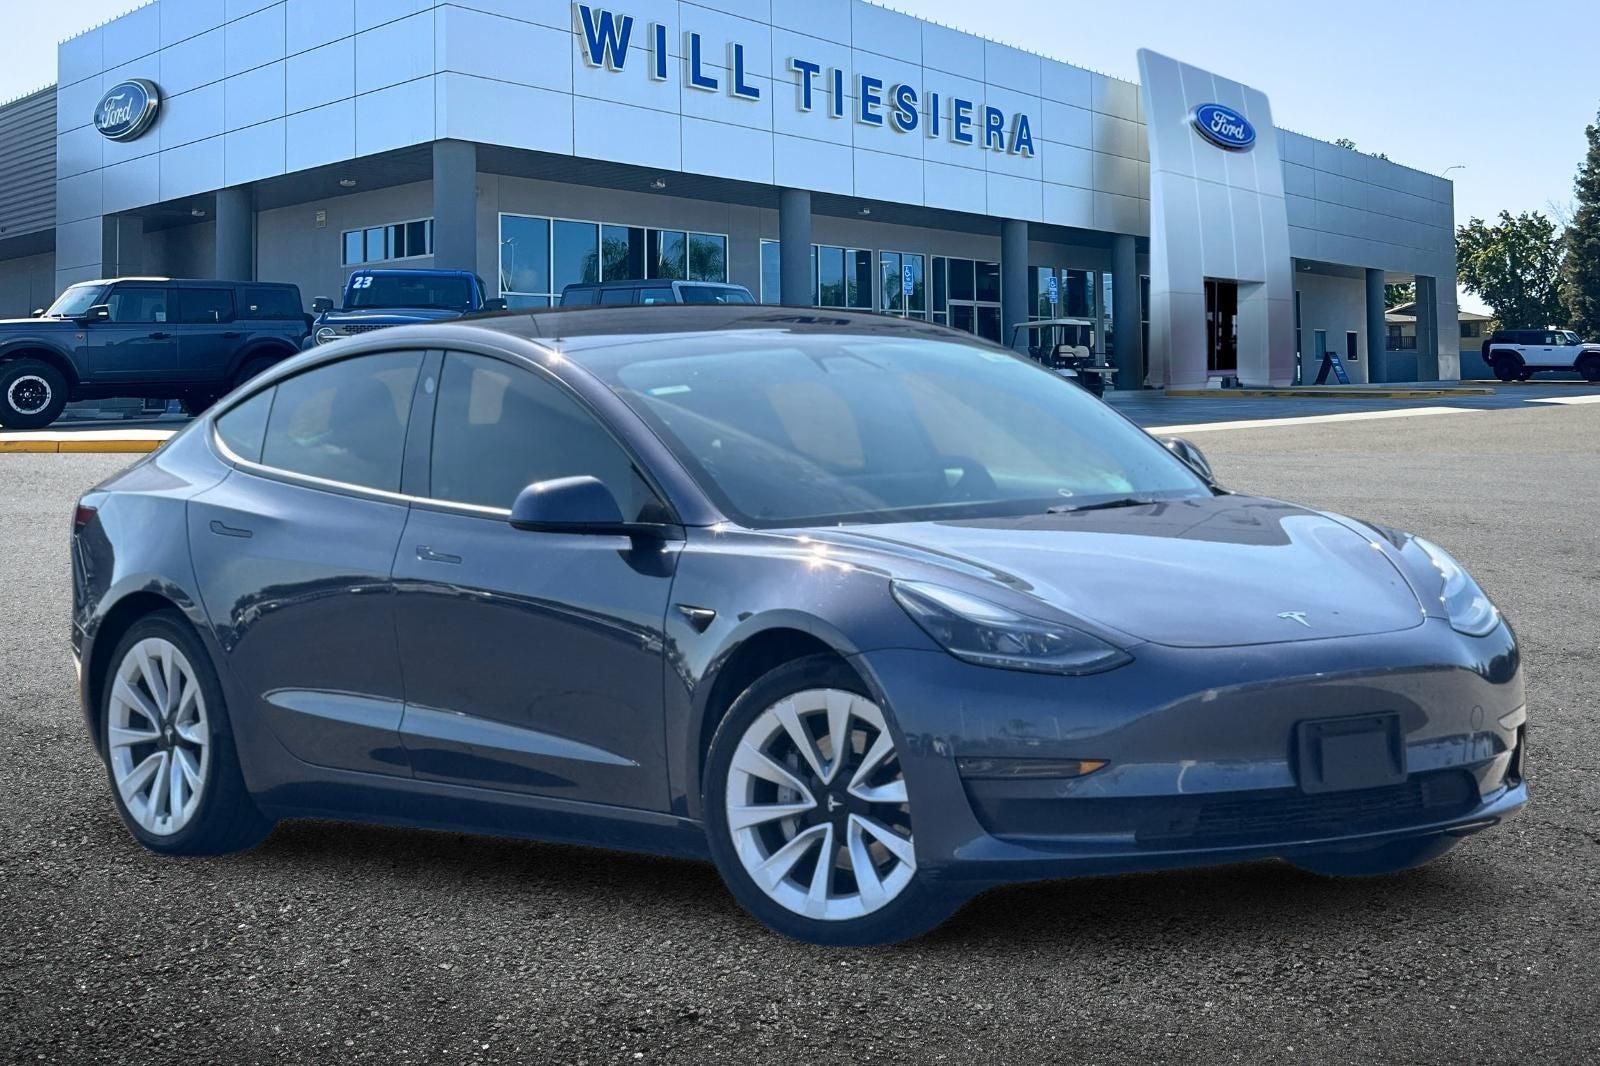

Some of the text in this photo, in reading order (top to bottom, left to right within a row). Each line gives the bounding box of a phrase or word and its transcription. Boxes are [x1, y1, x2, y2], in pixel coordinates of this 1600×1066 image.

[577, 3, 1035, 157] WILL TIESIERA
[101, 93, 133, 128] Ford
[1211, 111, 1245, 139] Ford
[352, 276, 374, 289] 23
